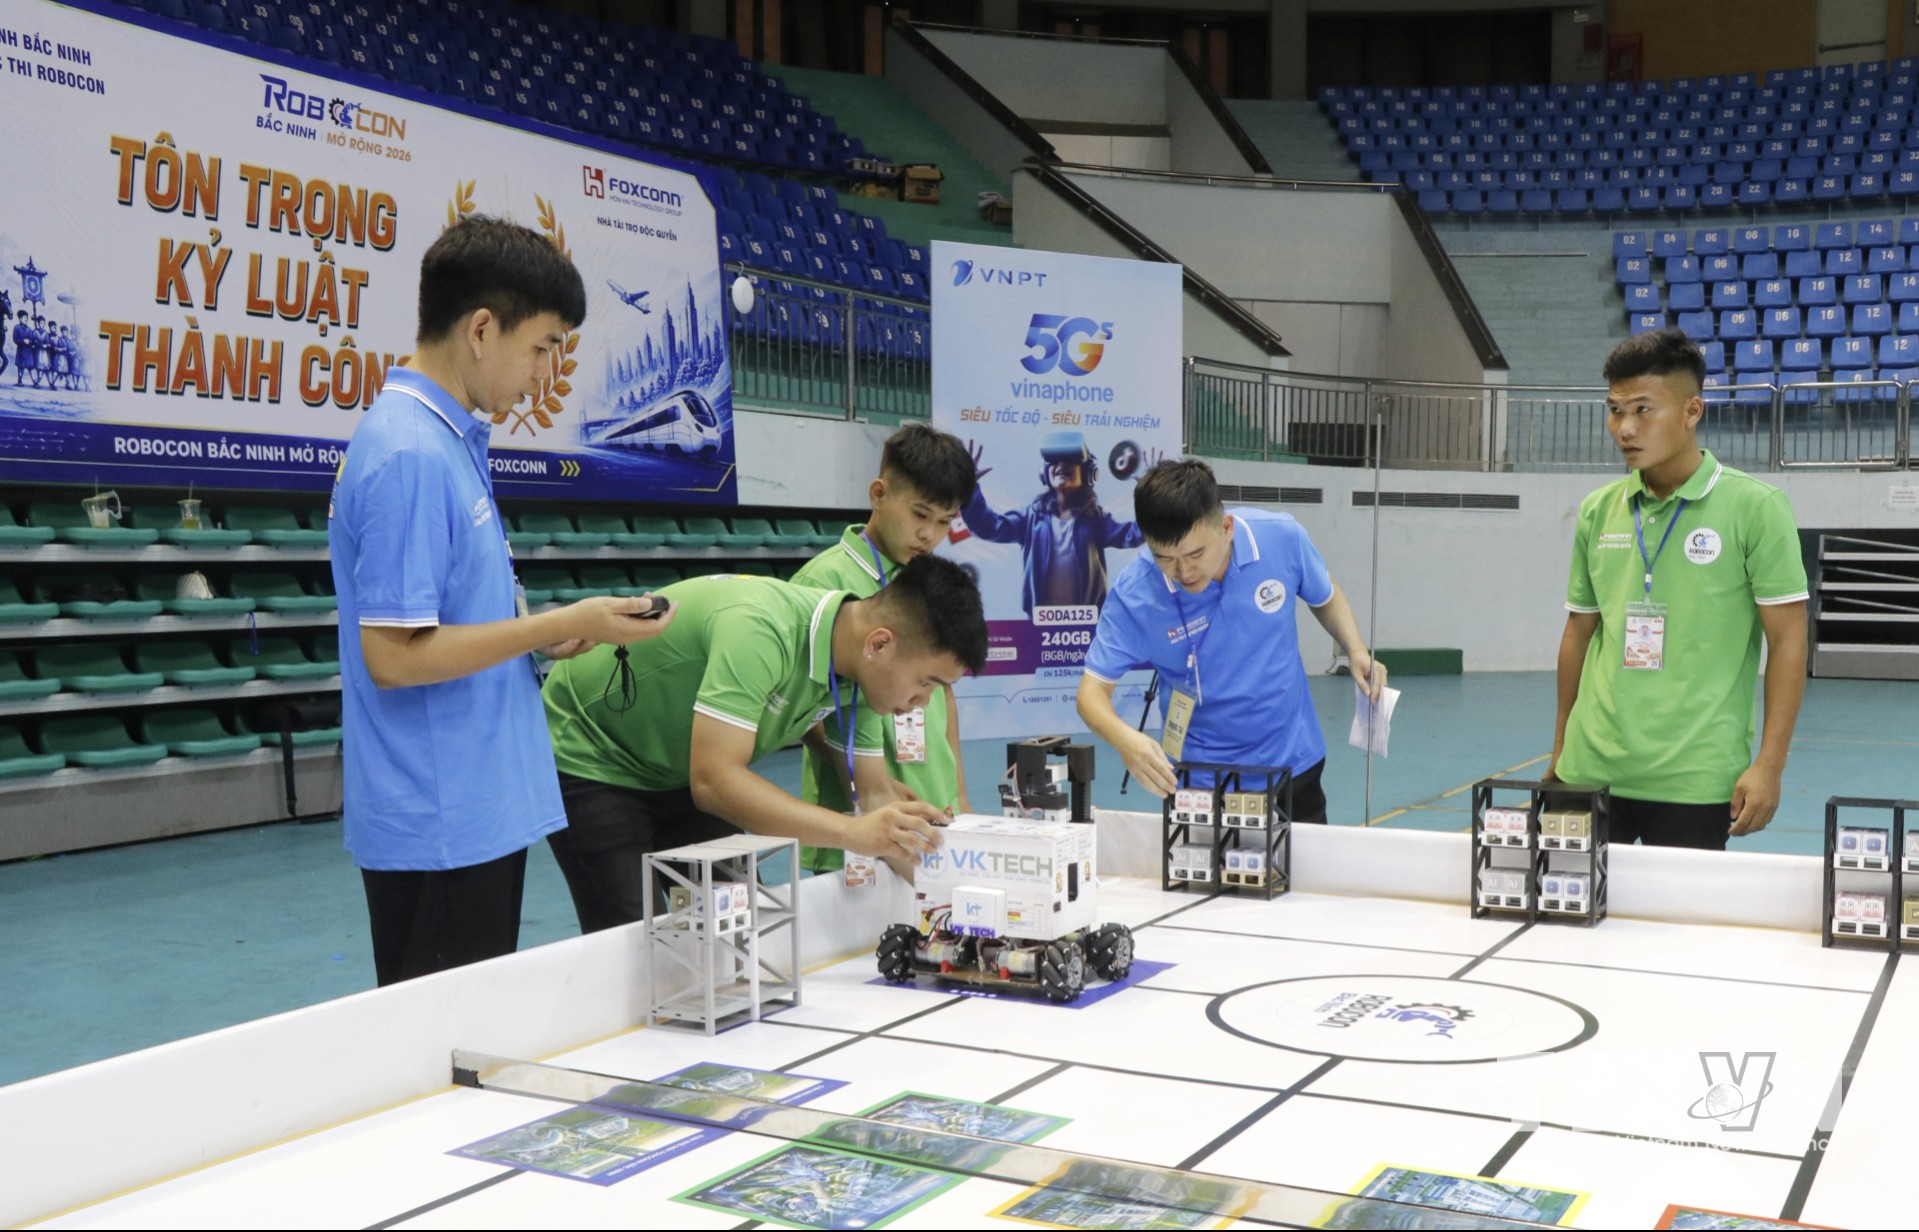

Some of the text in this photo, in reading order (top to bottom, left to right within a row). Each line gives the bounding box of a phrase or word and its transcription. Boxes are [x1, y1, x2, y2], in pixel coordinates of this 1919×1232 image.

[22, 32, 52, 56] BẮC
[57, 43, 91, 66] NINH
[7, 57, 32, 77] THI
[37, 64, 105, 95] ROBOCON
[256, 113, 411, 162] BẮC NINH MỞ RỘNG 2026
[110, 131, 397, 251] TÔN TRỌNG
[609, 177, 681, 208] FOXCONN
[597, 216, 677, 241] NHÀ TÀI TRỢ ĐỘC QUYỀN
[1788, 229, 1799, 238] 10
[1871, 224, 1882, 233] 14
[1624, 236, 1635, 244] 02
[1664, 234, 1676, 243] 04
[1706, 233, 1717, 242] 06
[1746, 231, 1758, 239] 08
[1840, 252, 1851, 262] 12
[1882, 250, 1894, 260] 14
[1628, 261, 1639, 270] 02
[1715, 259, 1727, 268] 06
[155, 227, 369, 337] KỶ LUẬT
[979, 268, 1047, 287] VNPT
[1903, 277, 1917, 287] 14
[1767, 282, 1780, 292] 08
[1812, 280, 1825, 291] 10
[1857, 278, 1870, 288] 12
[1636, 288, 1648, 297] 02
[1724, 285, 1736, 295] 06
[1775, 311, 1789, 321] 08
[1821, 310, 1834, 320] 10
[1867, 307, 1880, 317] 12
[1642, 317, 1654, 326] 02
[1732, 313, 1745, 324] 06
[1795, 342, 1809, 352] 08
[1846, 341, 1860, 352] 10
[1894, 339, 1908, 350] 12
[98, 315, 414, 413] THÀNH CÔN
[1011, 378, 1114, 404] vinaphone
[961, 405, 1160, 431] SIÊU TỐC ĐỘ SIÊU TRẢI NGHIỆM
[114, 437, 203, 458] ROBOCON
[207, 436, 241, 460] BẮC
[246, 445, 285, 463] NINH
[289, 443, 314, 464] MỞ
[318, 446, 347, 468] RỘN
[488, 458, 547, 475] FOXCONN
[1039, 610, 1093, 621] SODA125
[1041, 631, 1091, 646] 240GB
[969, 925, 996, 938] TECH
